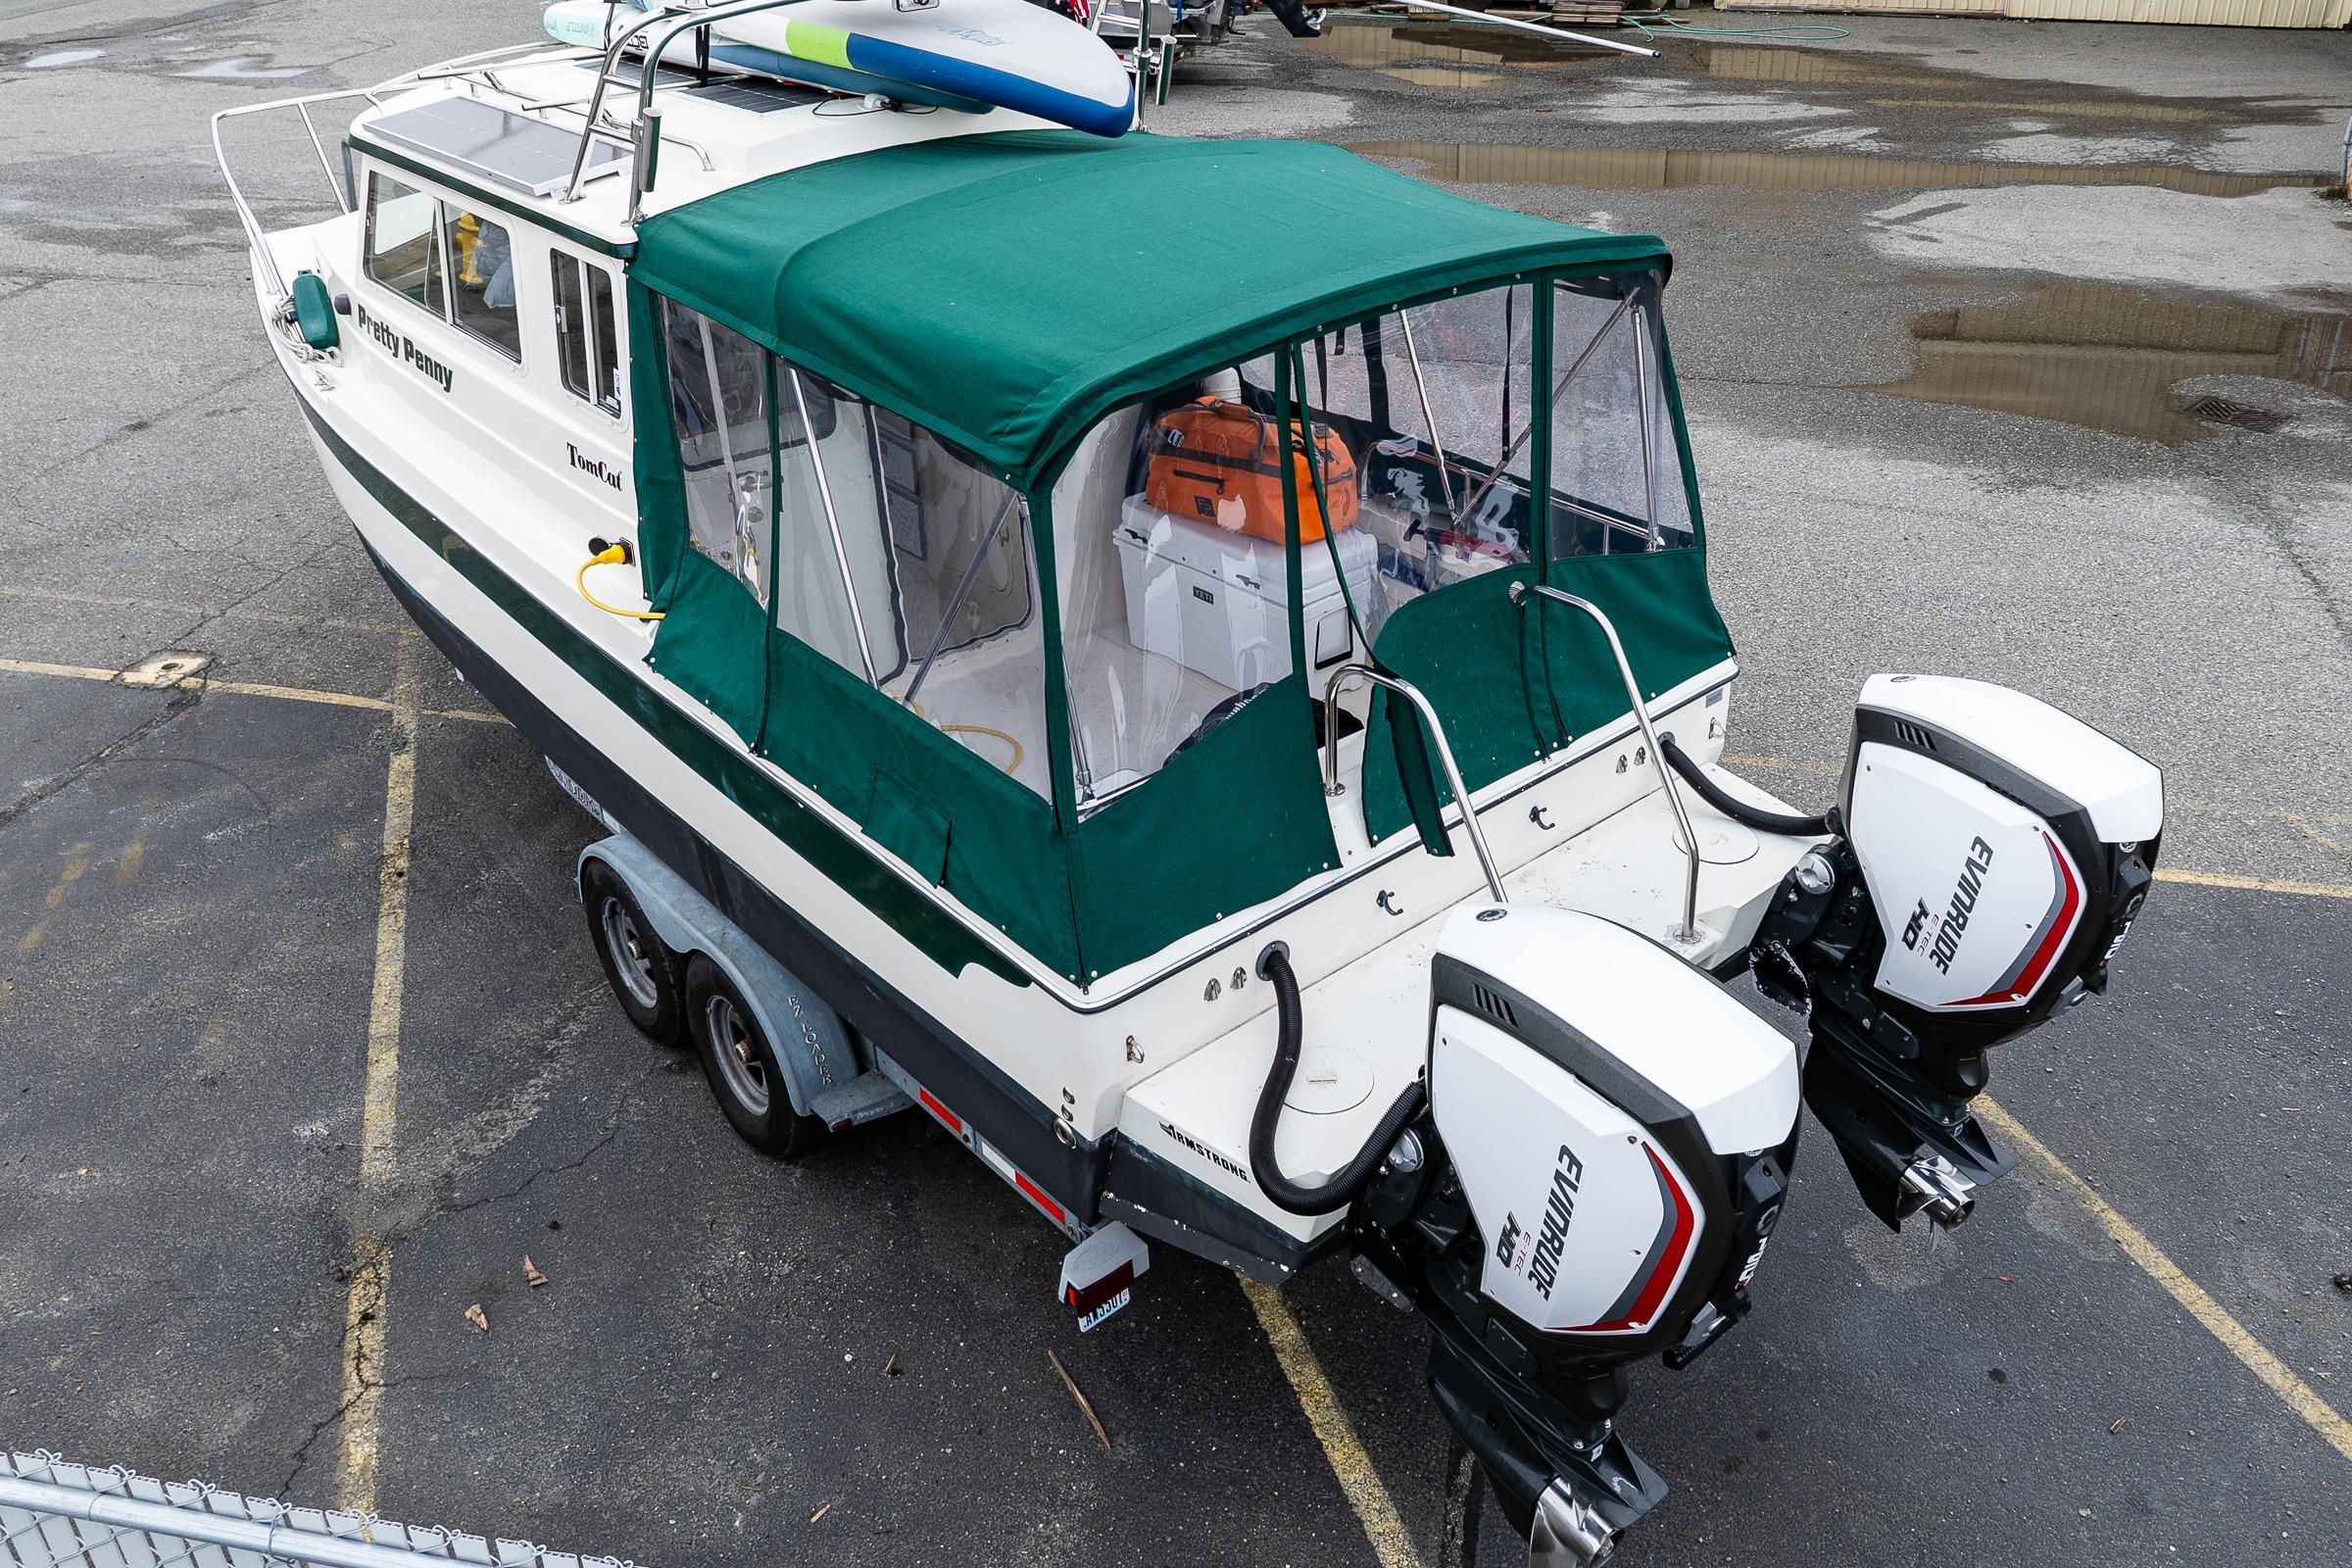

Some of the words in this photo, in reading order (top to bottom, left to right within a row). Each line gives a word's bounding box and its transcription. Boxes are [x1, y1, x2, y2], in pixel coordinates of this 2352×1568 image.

[358, 303, 400, 359] Pretty
[403, 335, 454, 393] Penny
[566, 441, 623, 492] TomCat
[1194, 587, 1213, 605] YETI
[1917, 913, 1939, 956] E-TEC
[1929, 836, 1994, 976] EVINRUDE
[802, 1020, 832, 1086] LOADER
[1158, 1120, 1250, 1183] ARMSTRONG
[1514, 1231, 1532, 1276] E-TEC
[1527, 1144, 1584, 1301] EVINRUDE
